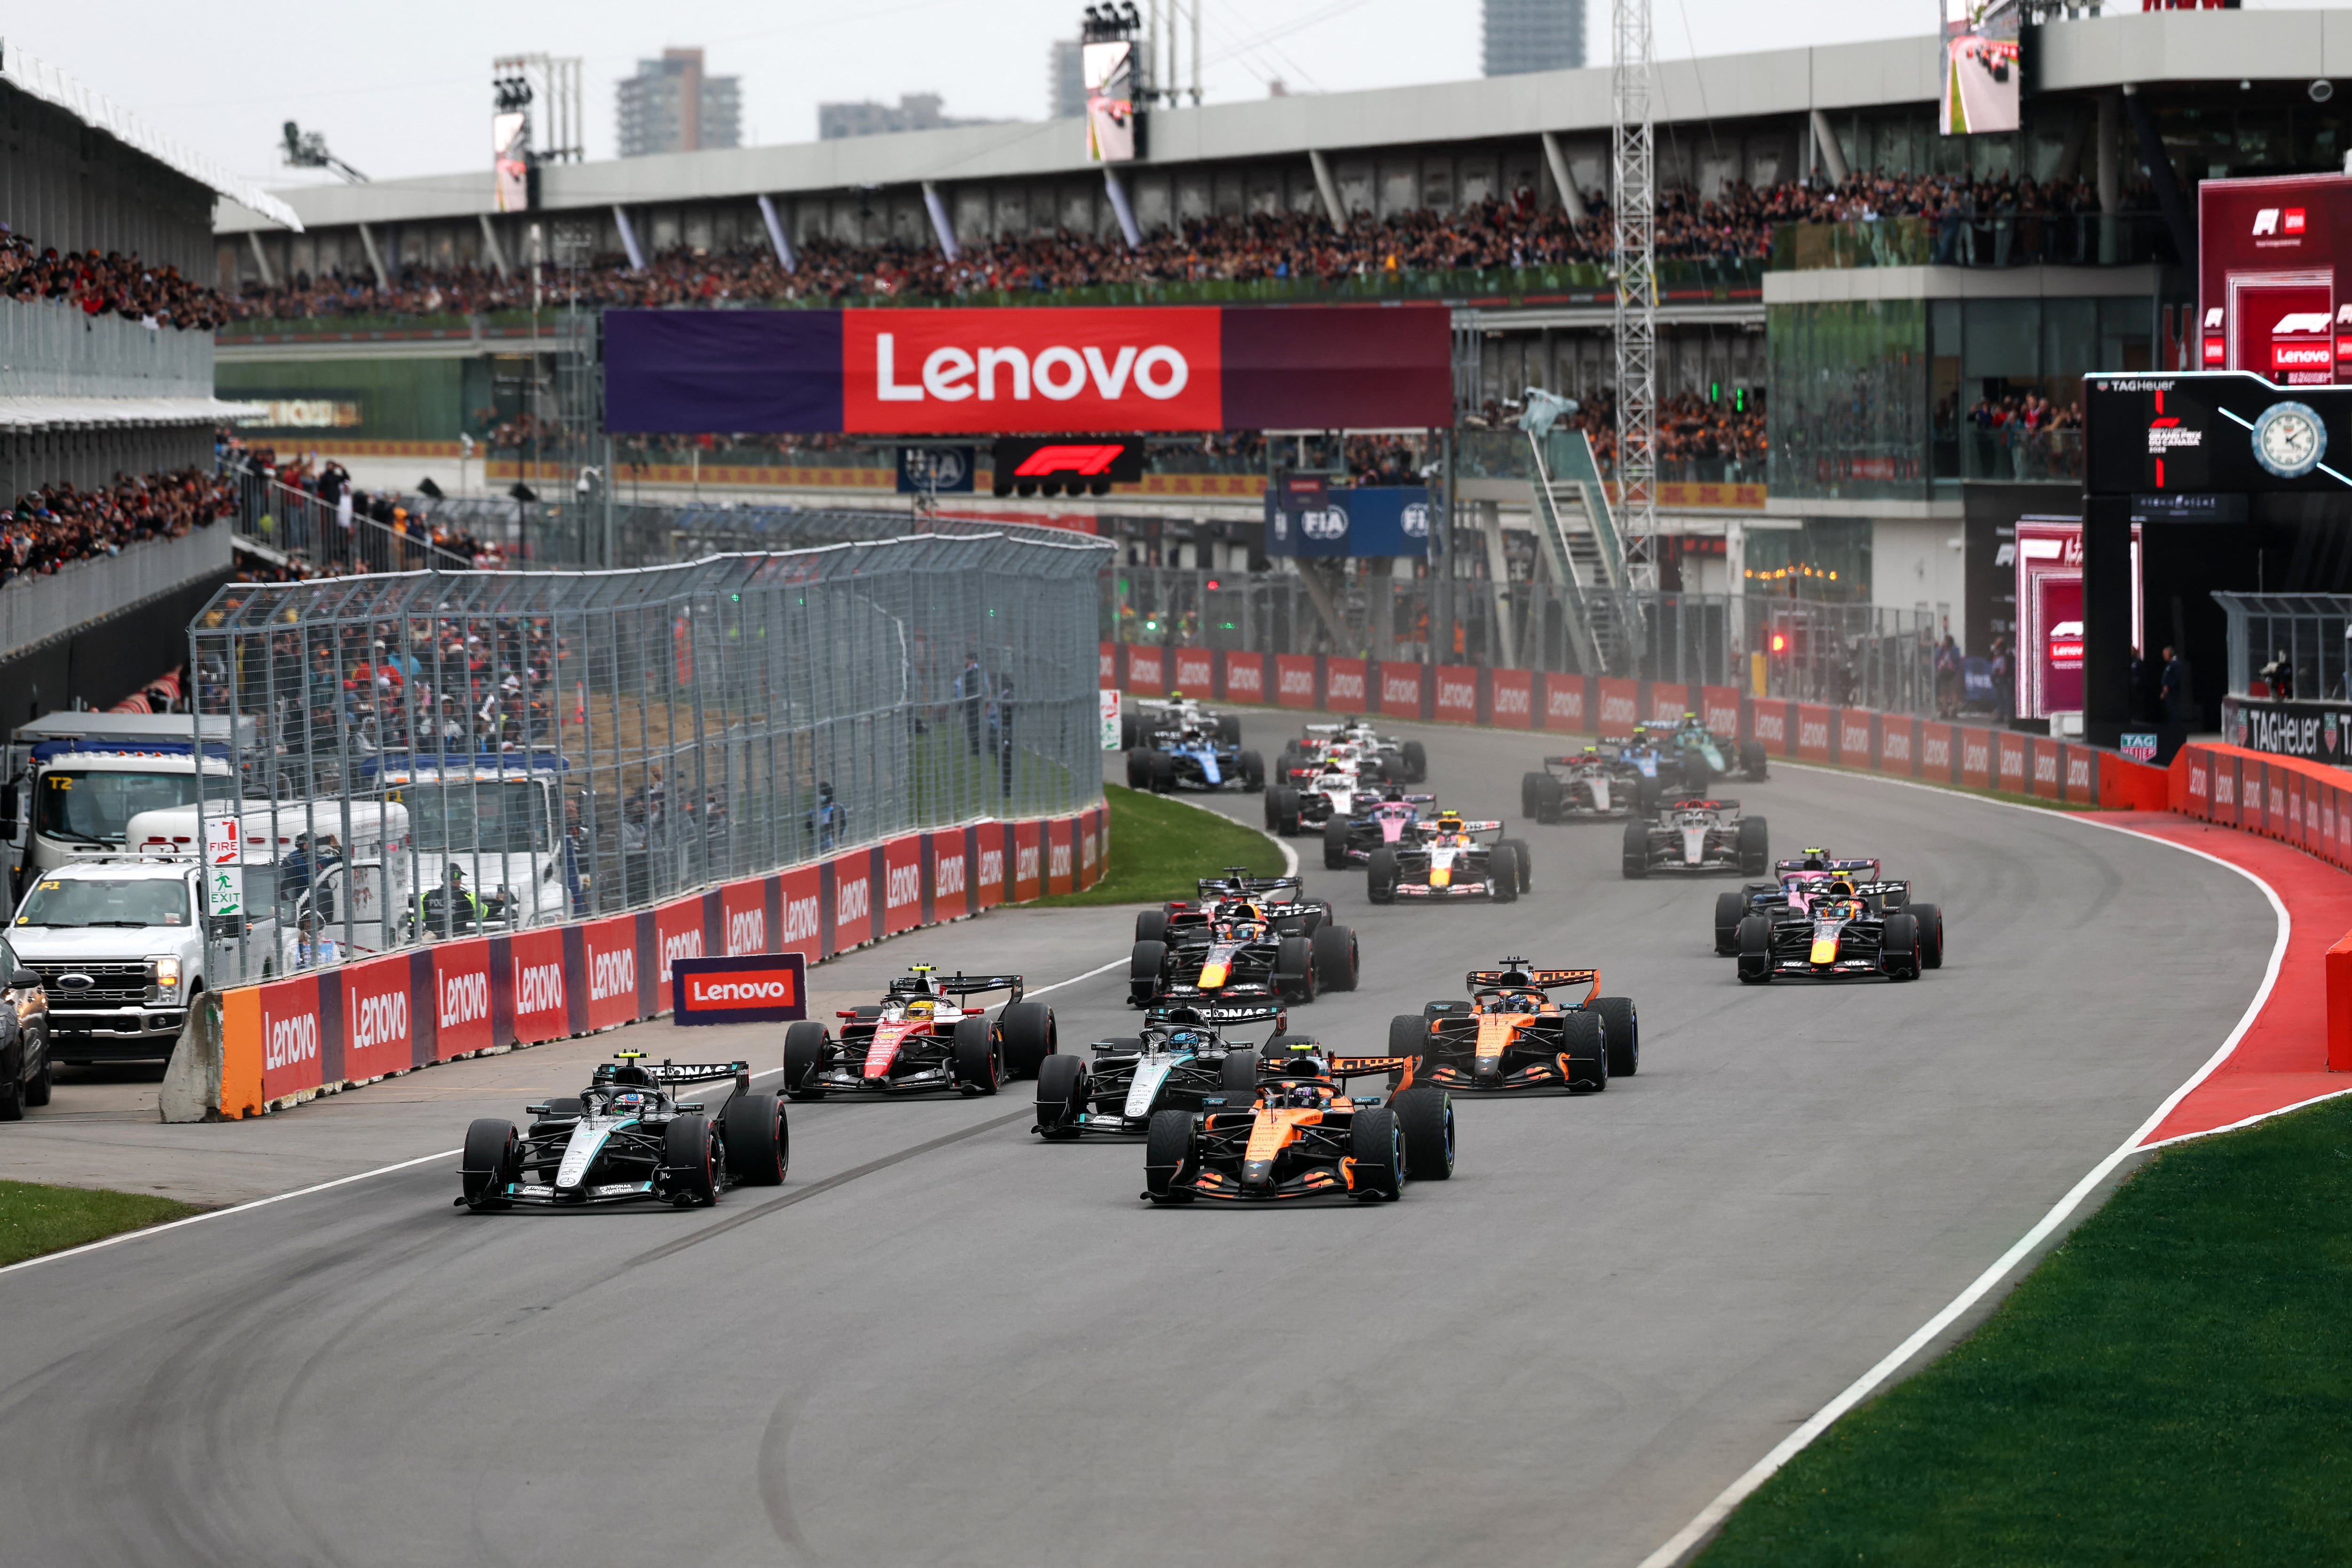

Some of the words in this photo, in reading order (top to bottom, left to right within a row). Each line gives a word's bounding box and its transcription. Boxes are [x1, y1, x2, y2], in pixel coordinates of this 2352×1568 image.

[877, 333, 1189, 401] Lenovo
[2277, 348, 2329, 363] Lenovo
[1305, 512, 1343, 532] FIA
[2052, 645, 2083, 656] Lenov
[1329, 667, 1363, 699] Lenovo
[1383, 671, 1418, 703] Lenovo
[1438, 676, 1474, 709] Lenovo
[1494, 681, 1528, 713] Lenovo
[1755, 706, 1783, 741] Lenovo
[1799, 715, 1827, 748] Lenovo
[1841, 719, 1868, 753] Lenovo
[2124, 735, 2154, 746] TAG
[1883, 725, 1909, 761] Lenovo
[1923, 731, 1948, 767] Lenovo
[1963, 737, 1987, 773] Lenovo
[2000, 743, 2022, 777] Lenovo
[48, 776, 72, 790] T2
[2035, 748, 2056, 783] Lenovo
[2067, 751, 2089, 787] Lenovo
[2189, 757, 2206, 797] Lenovo
[2216, 766, 2233, 804] Lenovo
[2243, 772, 2260, 809] Lenovo
[210, 842, 238, 852] FIRE
[978, 844, 1002, 886] Lenovo
[1016, 840, 1039, 882] Lenovo
[38, 881, 60, 891] F1
[886, 859, 919, 908] Lenovo
[936, 850, 964, 898] Lenovo
[211, 893, 240, 903] EXIT
[837, 876, 868, 926] Lenovo
[726, 905, 763, 956] Lenovo
[783, 891, 819, 944] Lenovo
[515, 956, 562, 1015] Lenovo
[588, 944, 634, 1001] Lenovo
[438, 968, 488, 1028] Lenovo
[694, 981, 785, 1001] Lenovo
[351, 987, 407, 1049] Lenovo
[265, 1011, 317, 1071] Lenovo
